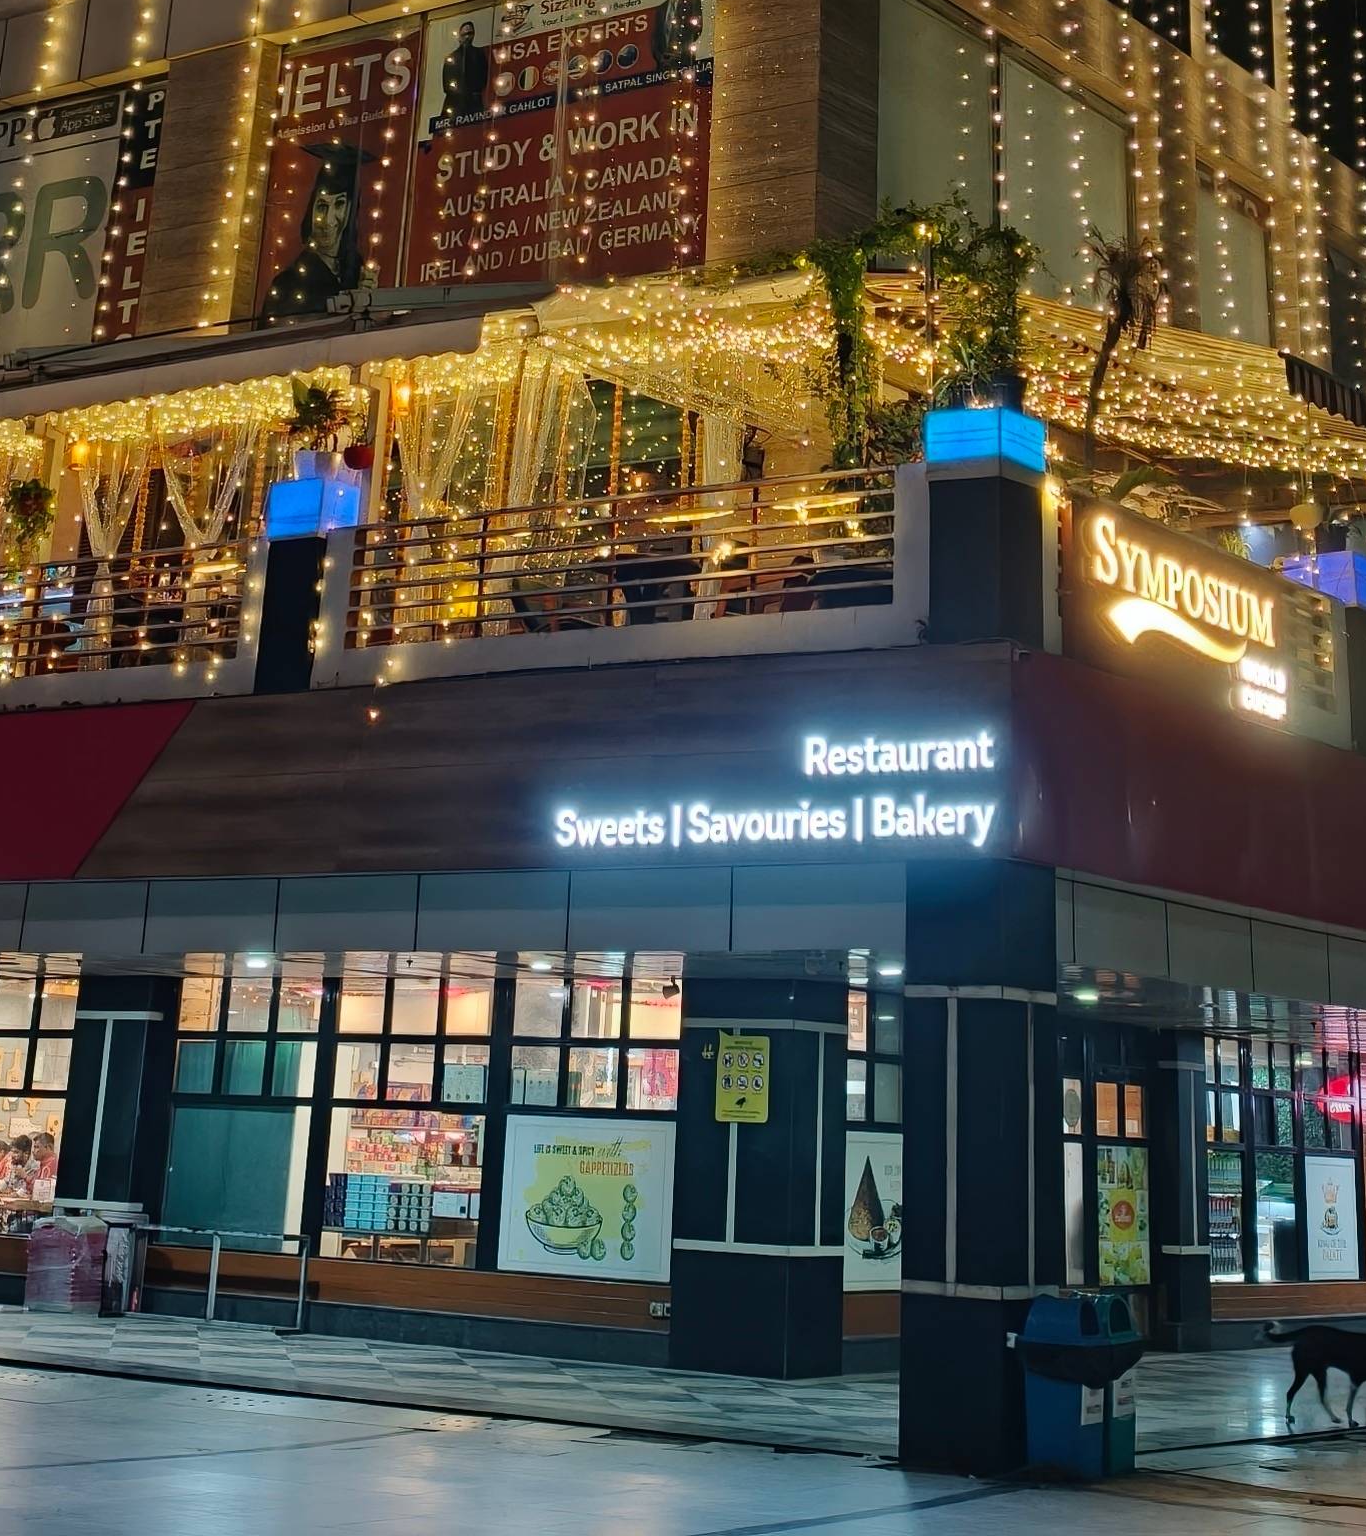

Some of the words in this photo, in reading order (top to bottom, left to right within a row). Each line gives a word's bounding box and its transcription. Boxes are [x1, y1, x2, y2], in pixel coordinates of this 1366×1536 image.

[547, 14, 648, 52] EXPERTS
[281, 47, 412, 117] IELTS
[455, 104, 507, 125] RAVINDR
[509, 96, 553, 114] GAHLOT
[605, 77, 642, 93] SATPAL
[139, 90, 166, 169] PTE
[436, 137, 532, 183] STUDY
[539, 133, 557, 162] &
[567, 111, 661, 156] WORK
[670, 104, 699, 133] IN
[442, 175, 565, 217] AUSTRALIA
[585, 156, 683, 191] CANADA
[419, 250, 504, 282] IRELAND
[520, 238, 581, 265] DUBAI
[598, 214, 703, 251] GERMANY
[436, 228, 464, 251] UK
[480, 219, 519, 244] USA
[535, 206, 580, 232] NEW
[584, 189, 681, 224] ZEALAND
[115, 198, 147, 340] IELT
[1091, 515, 1279, 649] SYMPOSIUM
[804, 730, 994, 779] Restaurant
[555, 807, 664, 848] Sweets
[687, 799, 845, 843] Savouries
[872, 793, 995, 848] Bakery
